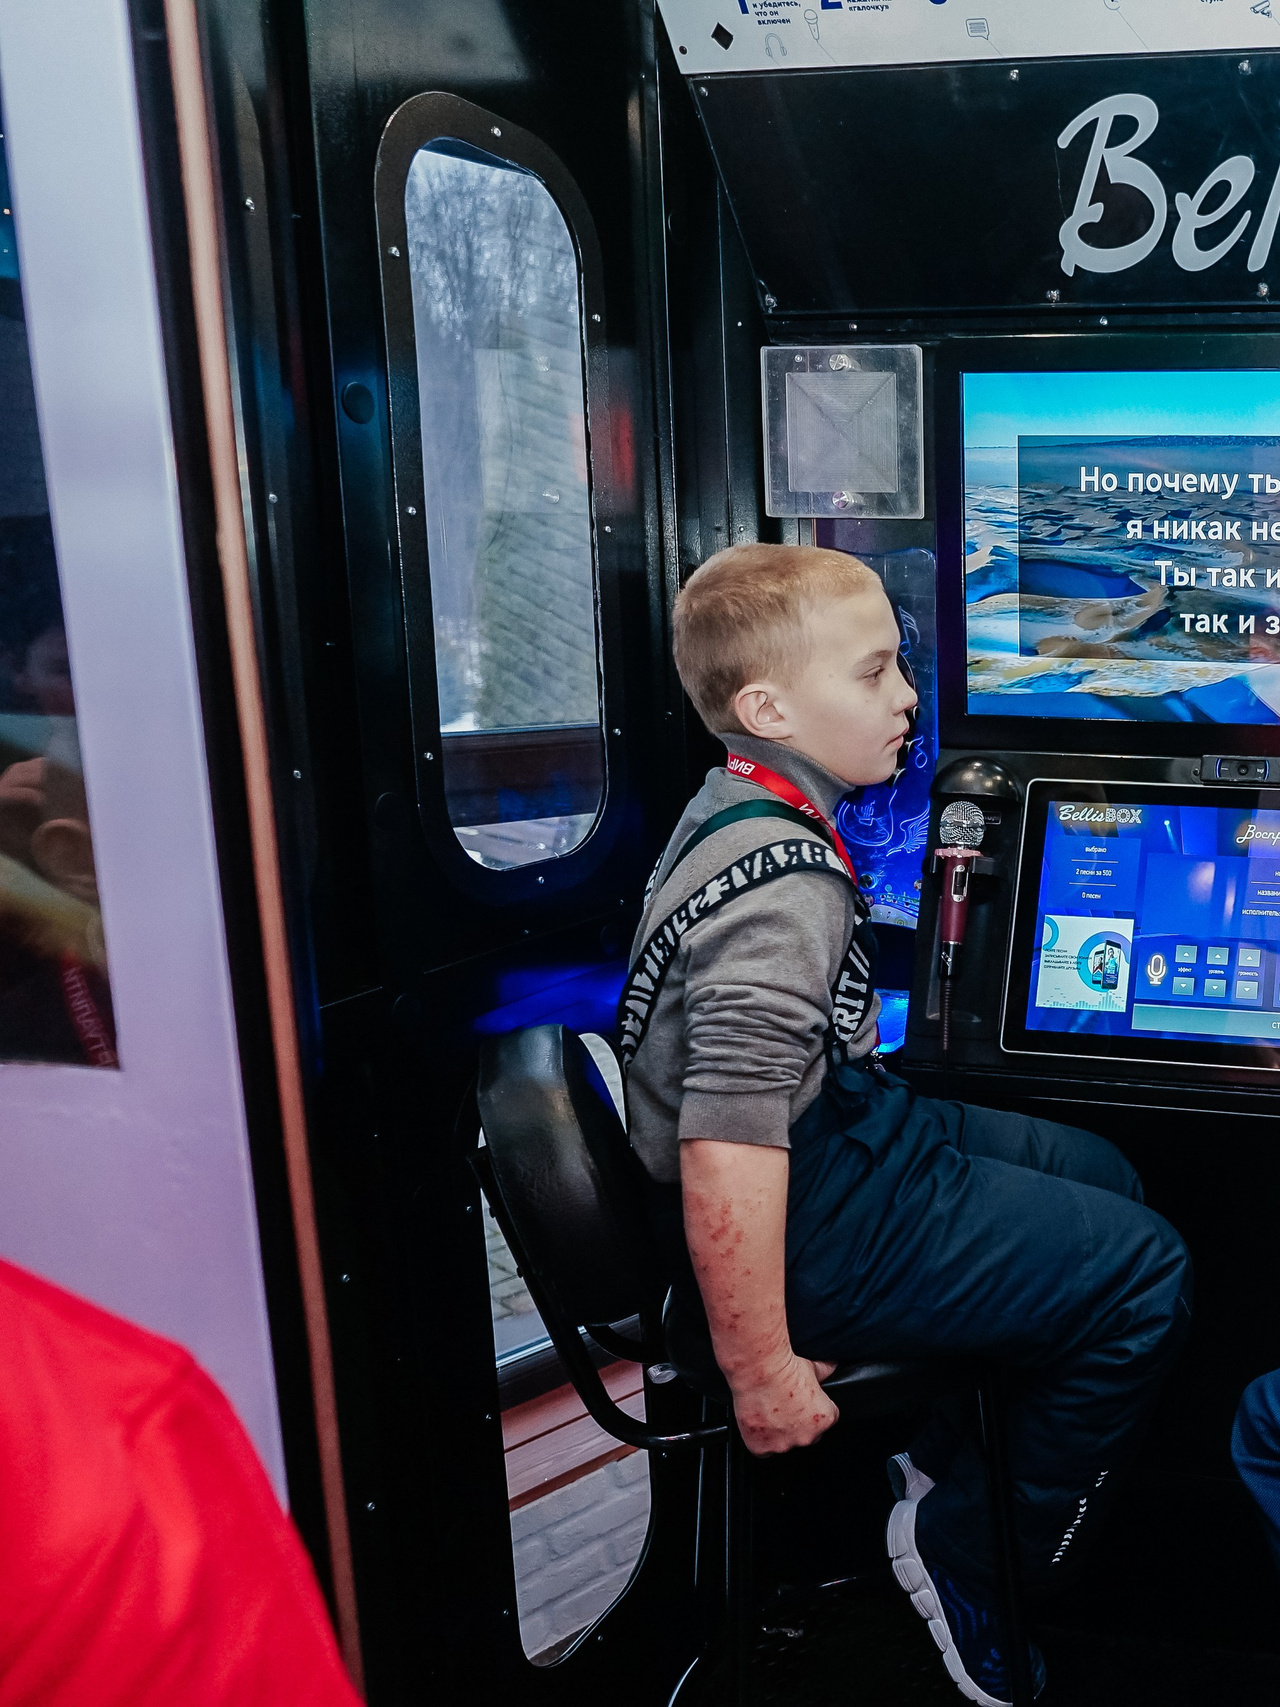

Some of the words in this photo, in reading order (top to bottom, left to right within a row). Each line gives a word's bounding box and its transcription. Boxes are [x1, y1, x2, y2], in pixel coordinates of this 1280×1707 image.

[1080, 466, 1117, 493] Но
[1128, 472, 1239, 500] почему
[1126, 519, 1143, 540] я
[1152, 519, 1242, 542] никак
[1154, 560, 1197, 588] Ты
[1207, 565, 1256, 589] так
[1180, 612, 1229, 634] так
[1238, 613, 1256, 635] и
[727, 755, 756, 775] ВИР
